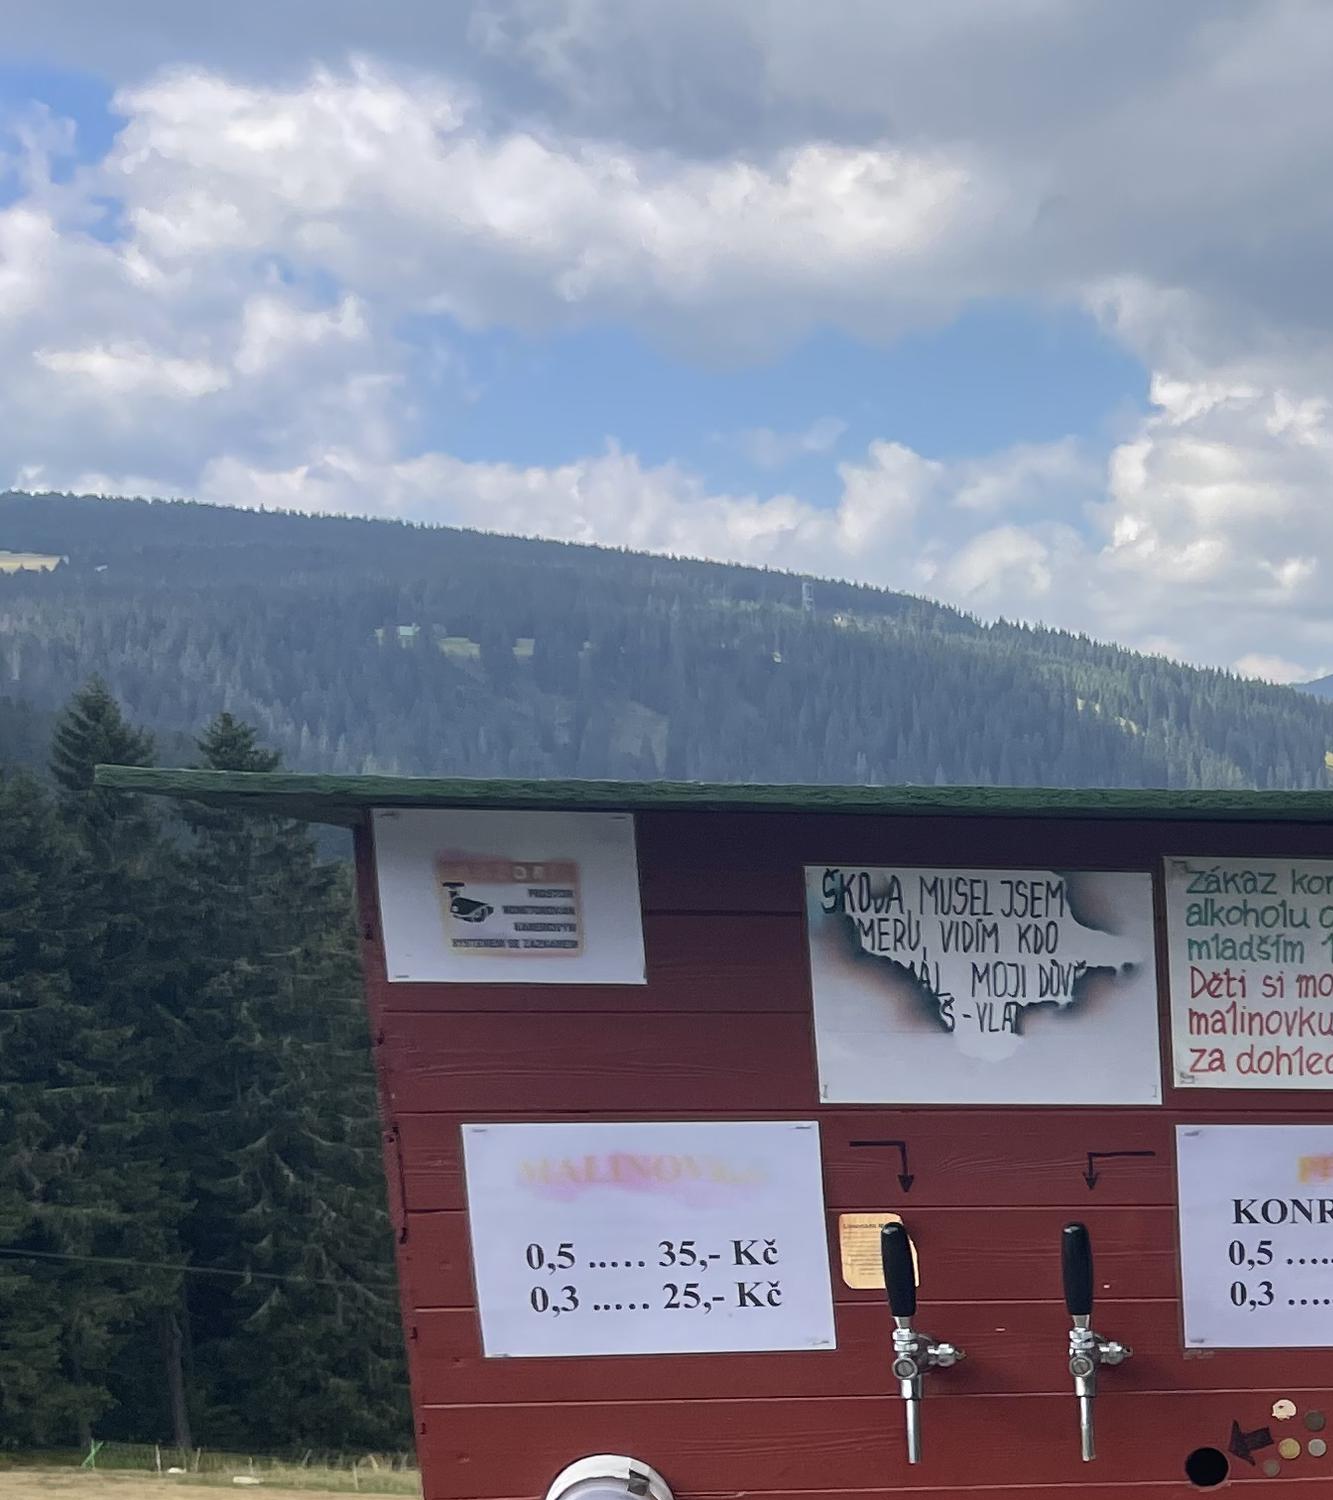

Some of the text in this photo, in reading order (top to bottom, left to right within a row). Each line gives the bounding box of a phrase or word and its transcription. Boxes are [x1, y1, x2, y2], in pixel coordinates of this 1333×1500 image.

[919, 875, 994, 917] MUSEL
[1000, 879, 1065, 918] JSEM
[1186, 898, 1310, 929] alkoholu
[1017, 920, 1059, 954] KDO
[1187, 933, 1305, 964] mladším
[971, 960, 1027, 998] MOJI
[1190, 966, 1247, 999] Děti
[1262, 971, 1285, 998] si
[525, 1242, 576, 1274] 0,5
[658, 1240, 721, 1272] 35,-
[730, 1238, 779, 1266] Kč
[1228, 1239, 1274, 1271] 0,5
[530, 1285, 580, 1317] 0,3
[662, 1282, 725, 1314] 25,-
[735, 1280, 782, 1308] Kč
[1230, 1280, 1275, 1312] 0,3
